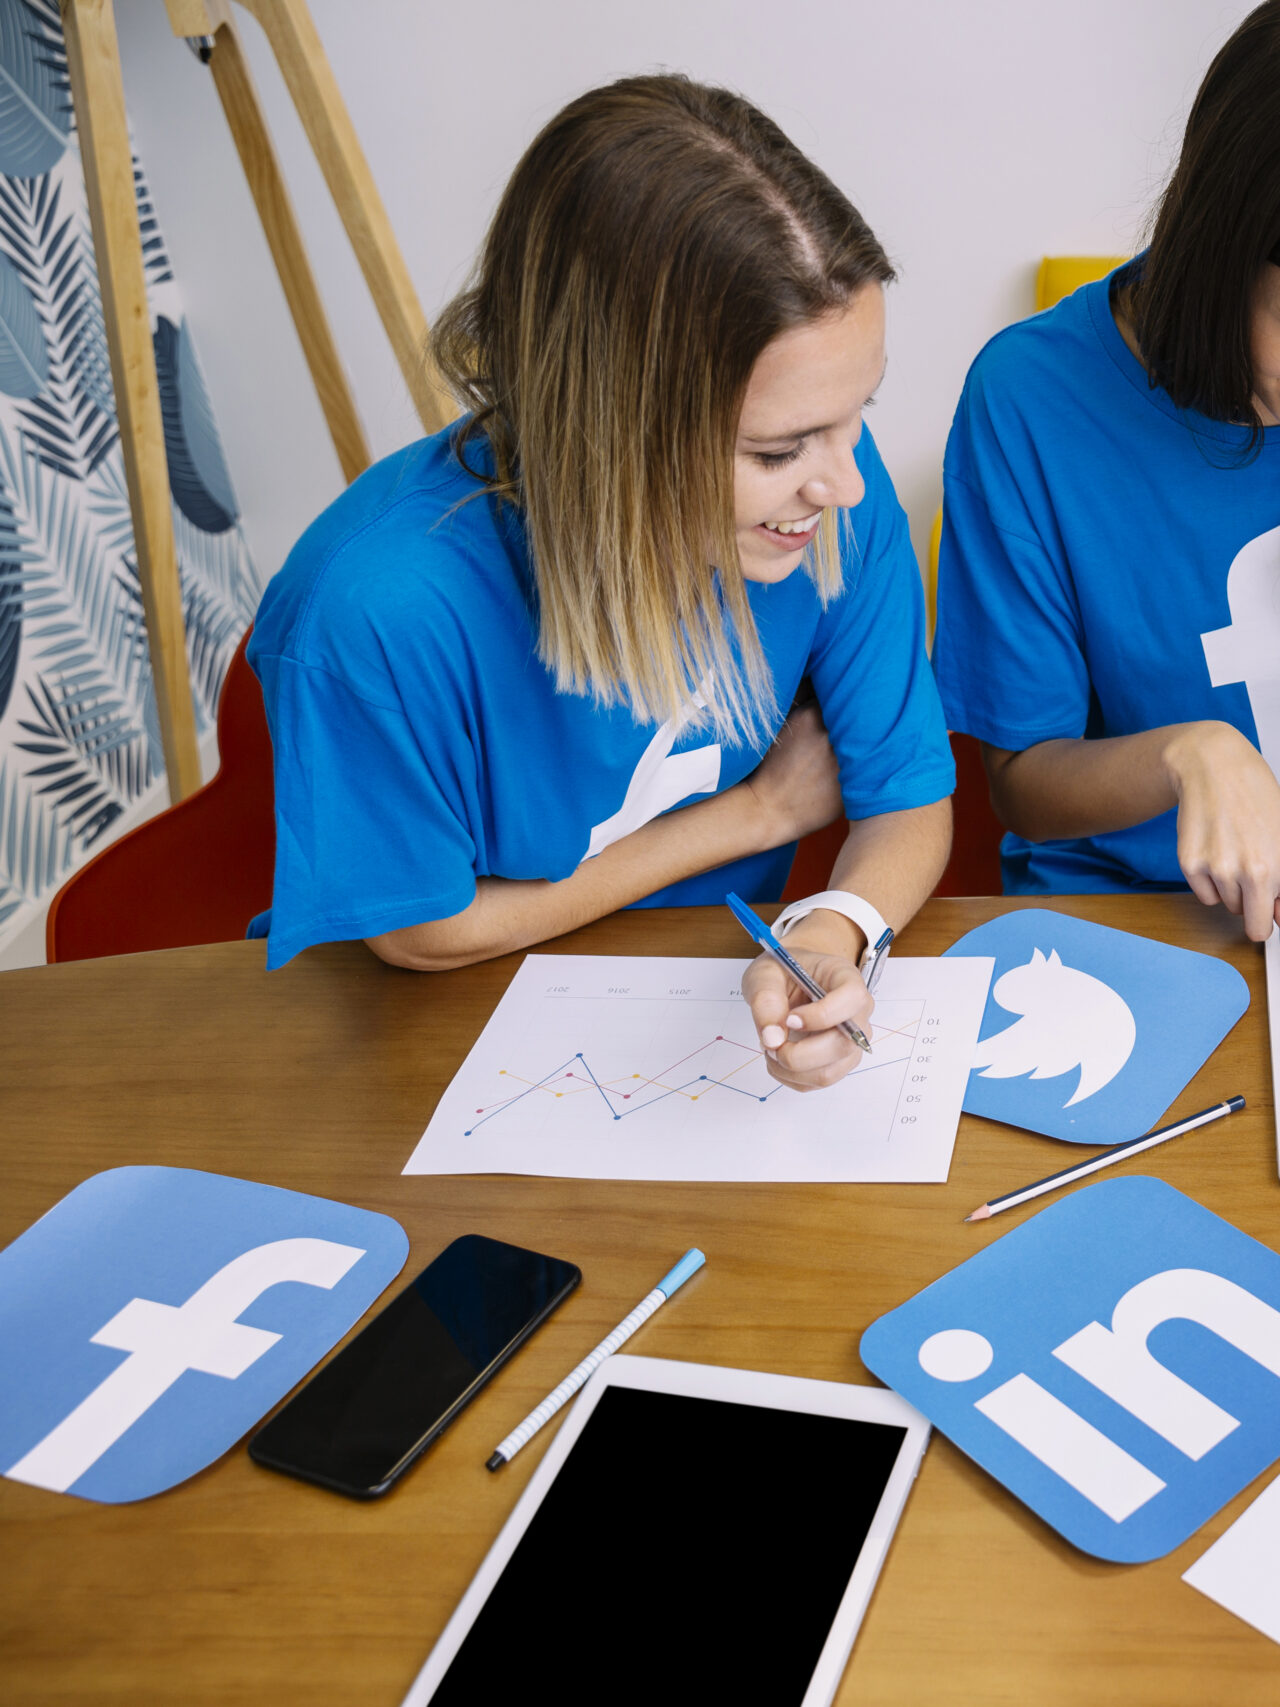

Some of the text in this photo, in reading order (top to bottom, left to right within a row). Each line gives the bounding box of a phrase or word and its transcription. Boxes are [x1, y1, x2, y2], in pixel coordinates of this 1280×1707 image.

[668, 987, 692, 996] 2015
[926, 1017, 941, 1026] 10
[921, 1036, 937, 1045] 20
[916, 1055, 932, 1063] 30
[911, 1074, 928, 1083] 40
[906, 1094, 921, 1103] 50
[900, 1115, 917, 1124] 60
